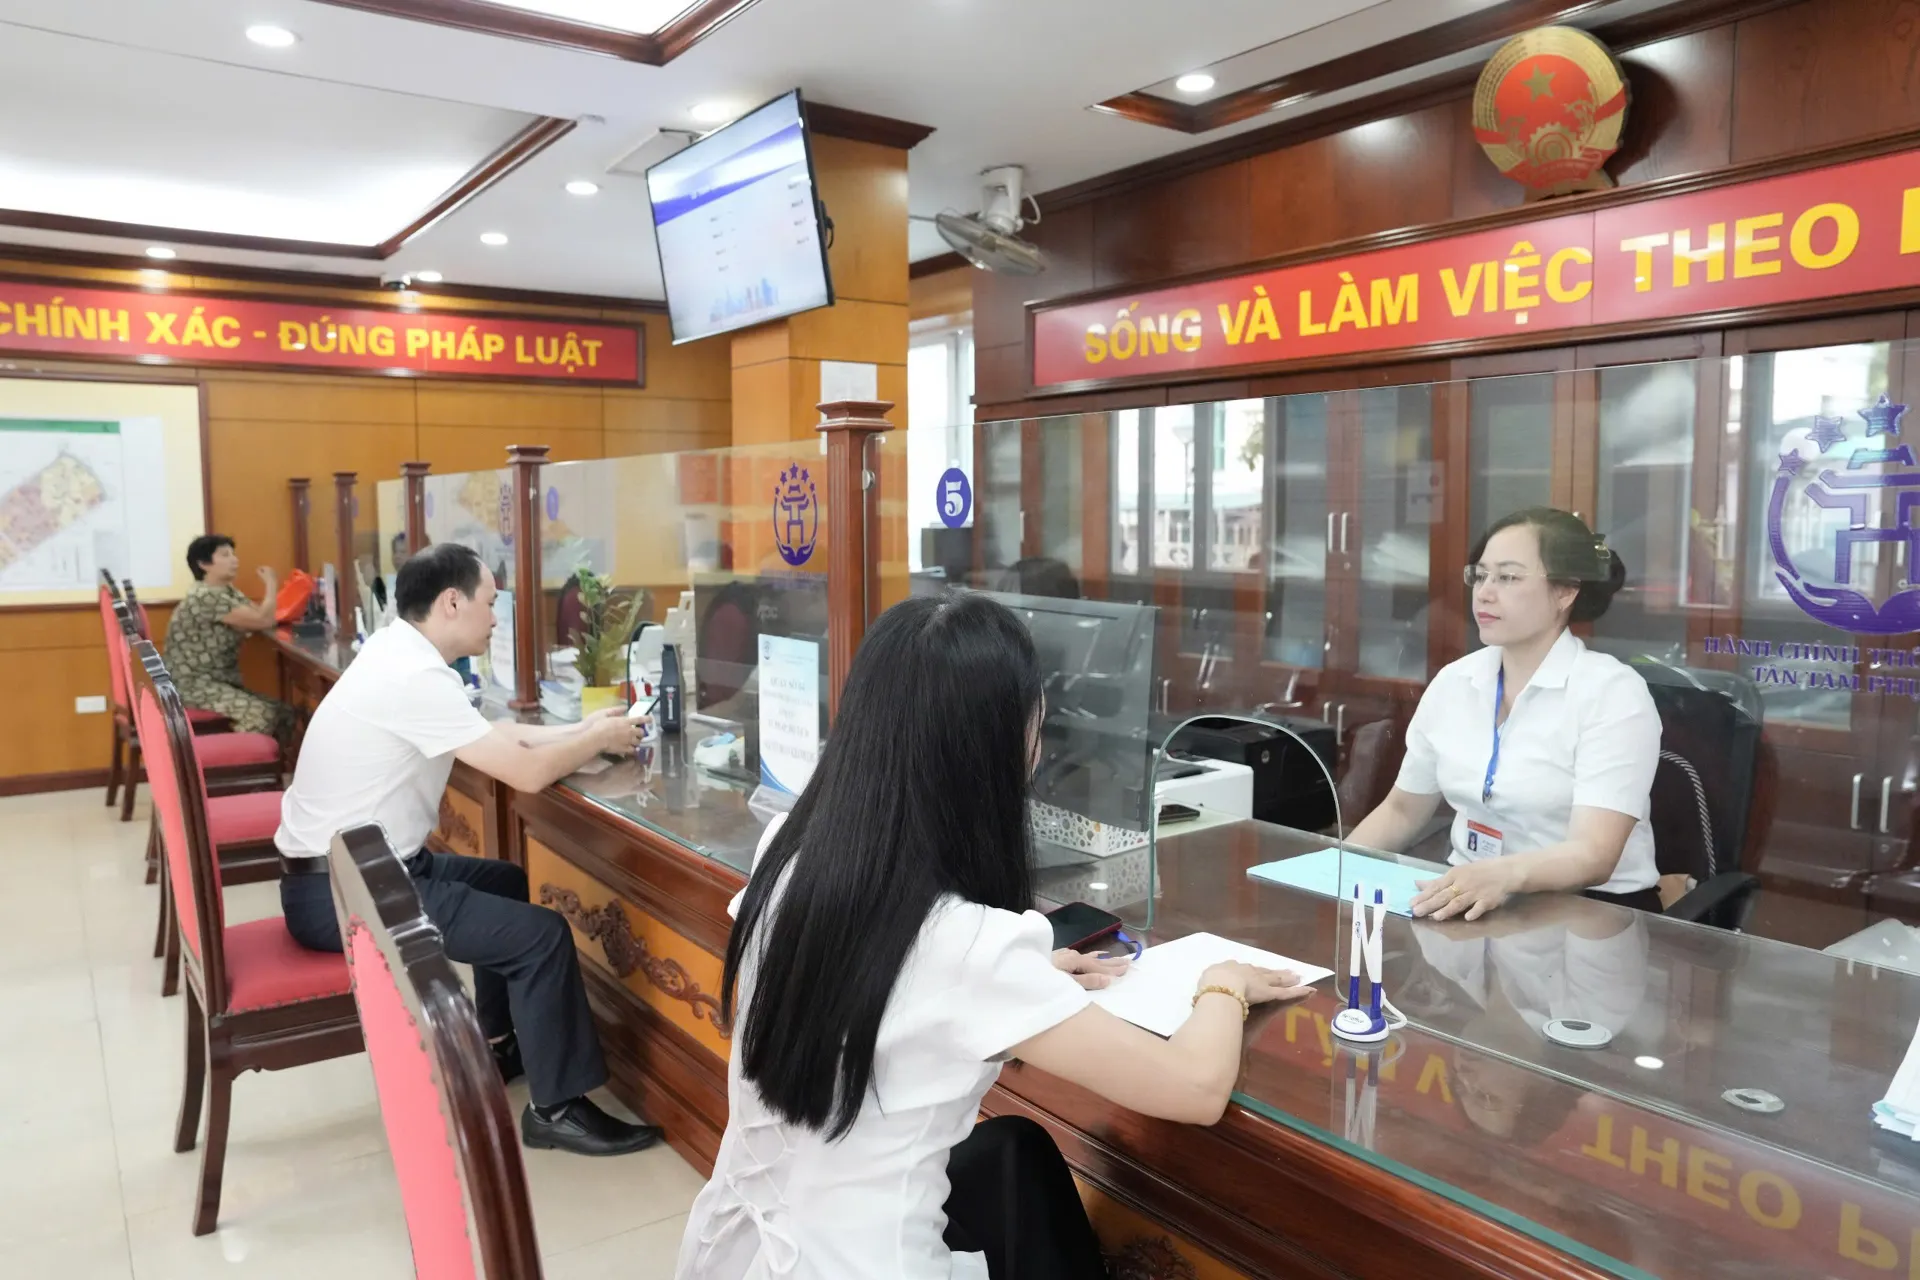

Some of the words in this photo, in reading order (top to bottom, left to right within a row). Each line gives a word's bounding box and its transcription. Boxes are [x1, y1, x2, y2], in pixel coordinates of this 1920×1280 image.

[1084, 303, 1202, 364] SỐNG
[1218, 284, 1281, 346] VÀ
[1299, 271, 1420, 337] LÀM
[1439, 241, 1594, 325] VIỆC
[1619, 203, 1861, 292] THEO
[144, 306, 241, 349] XÁC
[277, 316, 396, 356] ĐÚNG
[406, 325, 504, 362] PHÁP
[515, 333, 602, 373] LUẬT
[944, 480, 964, 517] 5
[1704, 634, 1776, 657] HÀNH
[1752, 664, 1798, 688] TẬN
